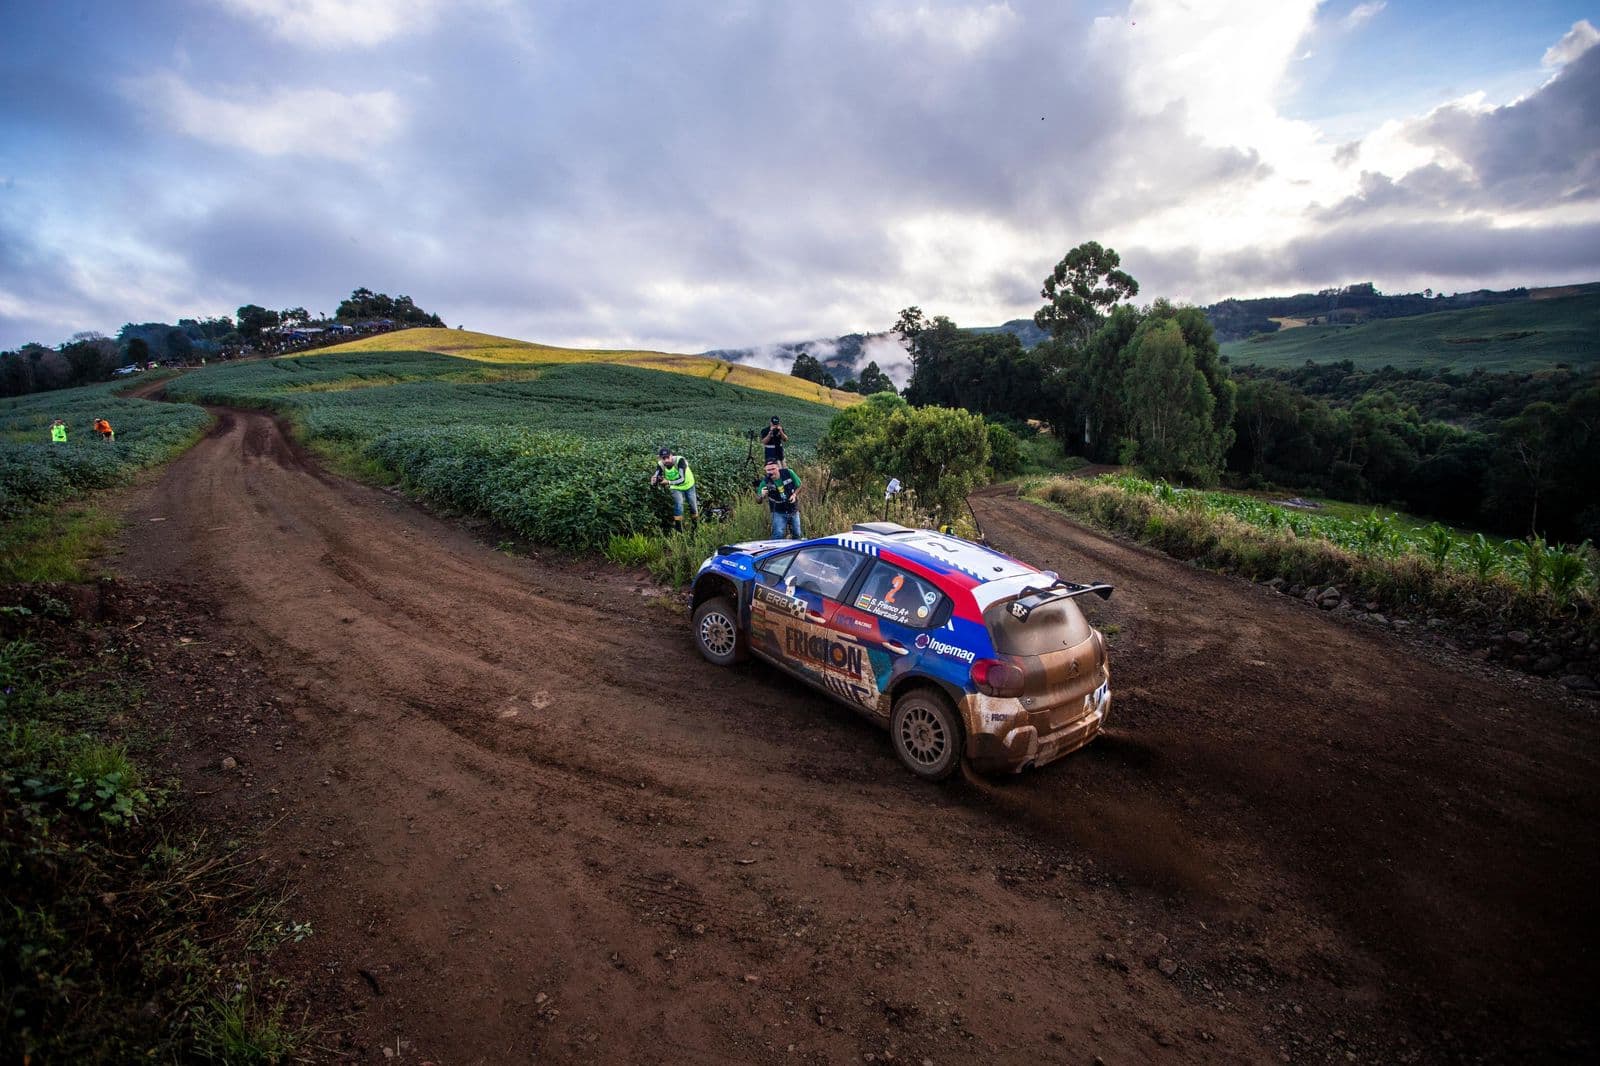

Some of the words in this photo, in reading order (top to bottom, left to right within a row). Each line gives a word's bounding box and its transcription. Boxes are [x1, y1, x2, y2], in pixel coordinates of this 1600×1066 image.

[884, 573, 906, 603] 2
[877, 600, 899, 613] Franco
[929, 637, 976, 664] Ingemaq
